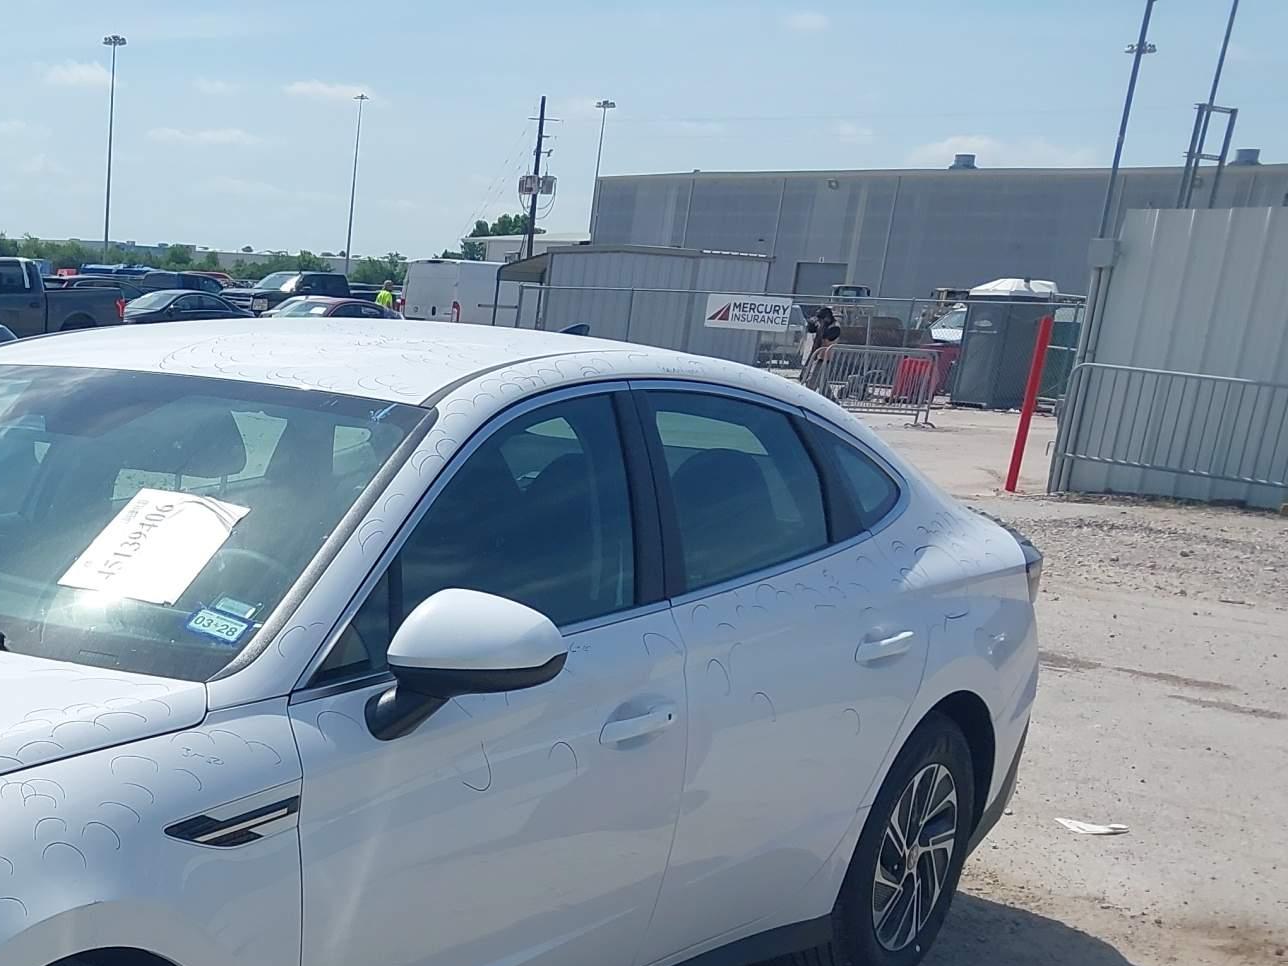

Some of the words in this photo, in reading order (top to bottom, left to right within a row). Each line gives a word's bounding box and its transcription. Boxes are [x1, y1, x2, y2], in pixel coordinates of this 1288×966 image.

[732, 302, 790, 316] MERCURY
[731, 314, 788, 326] INSURANCE
[96, 503, 175, 581] 45139406
